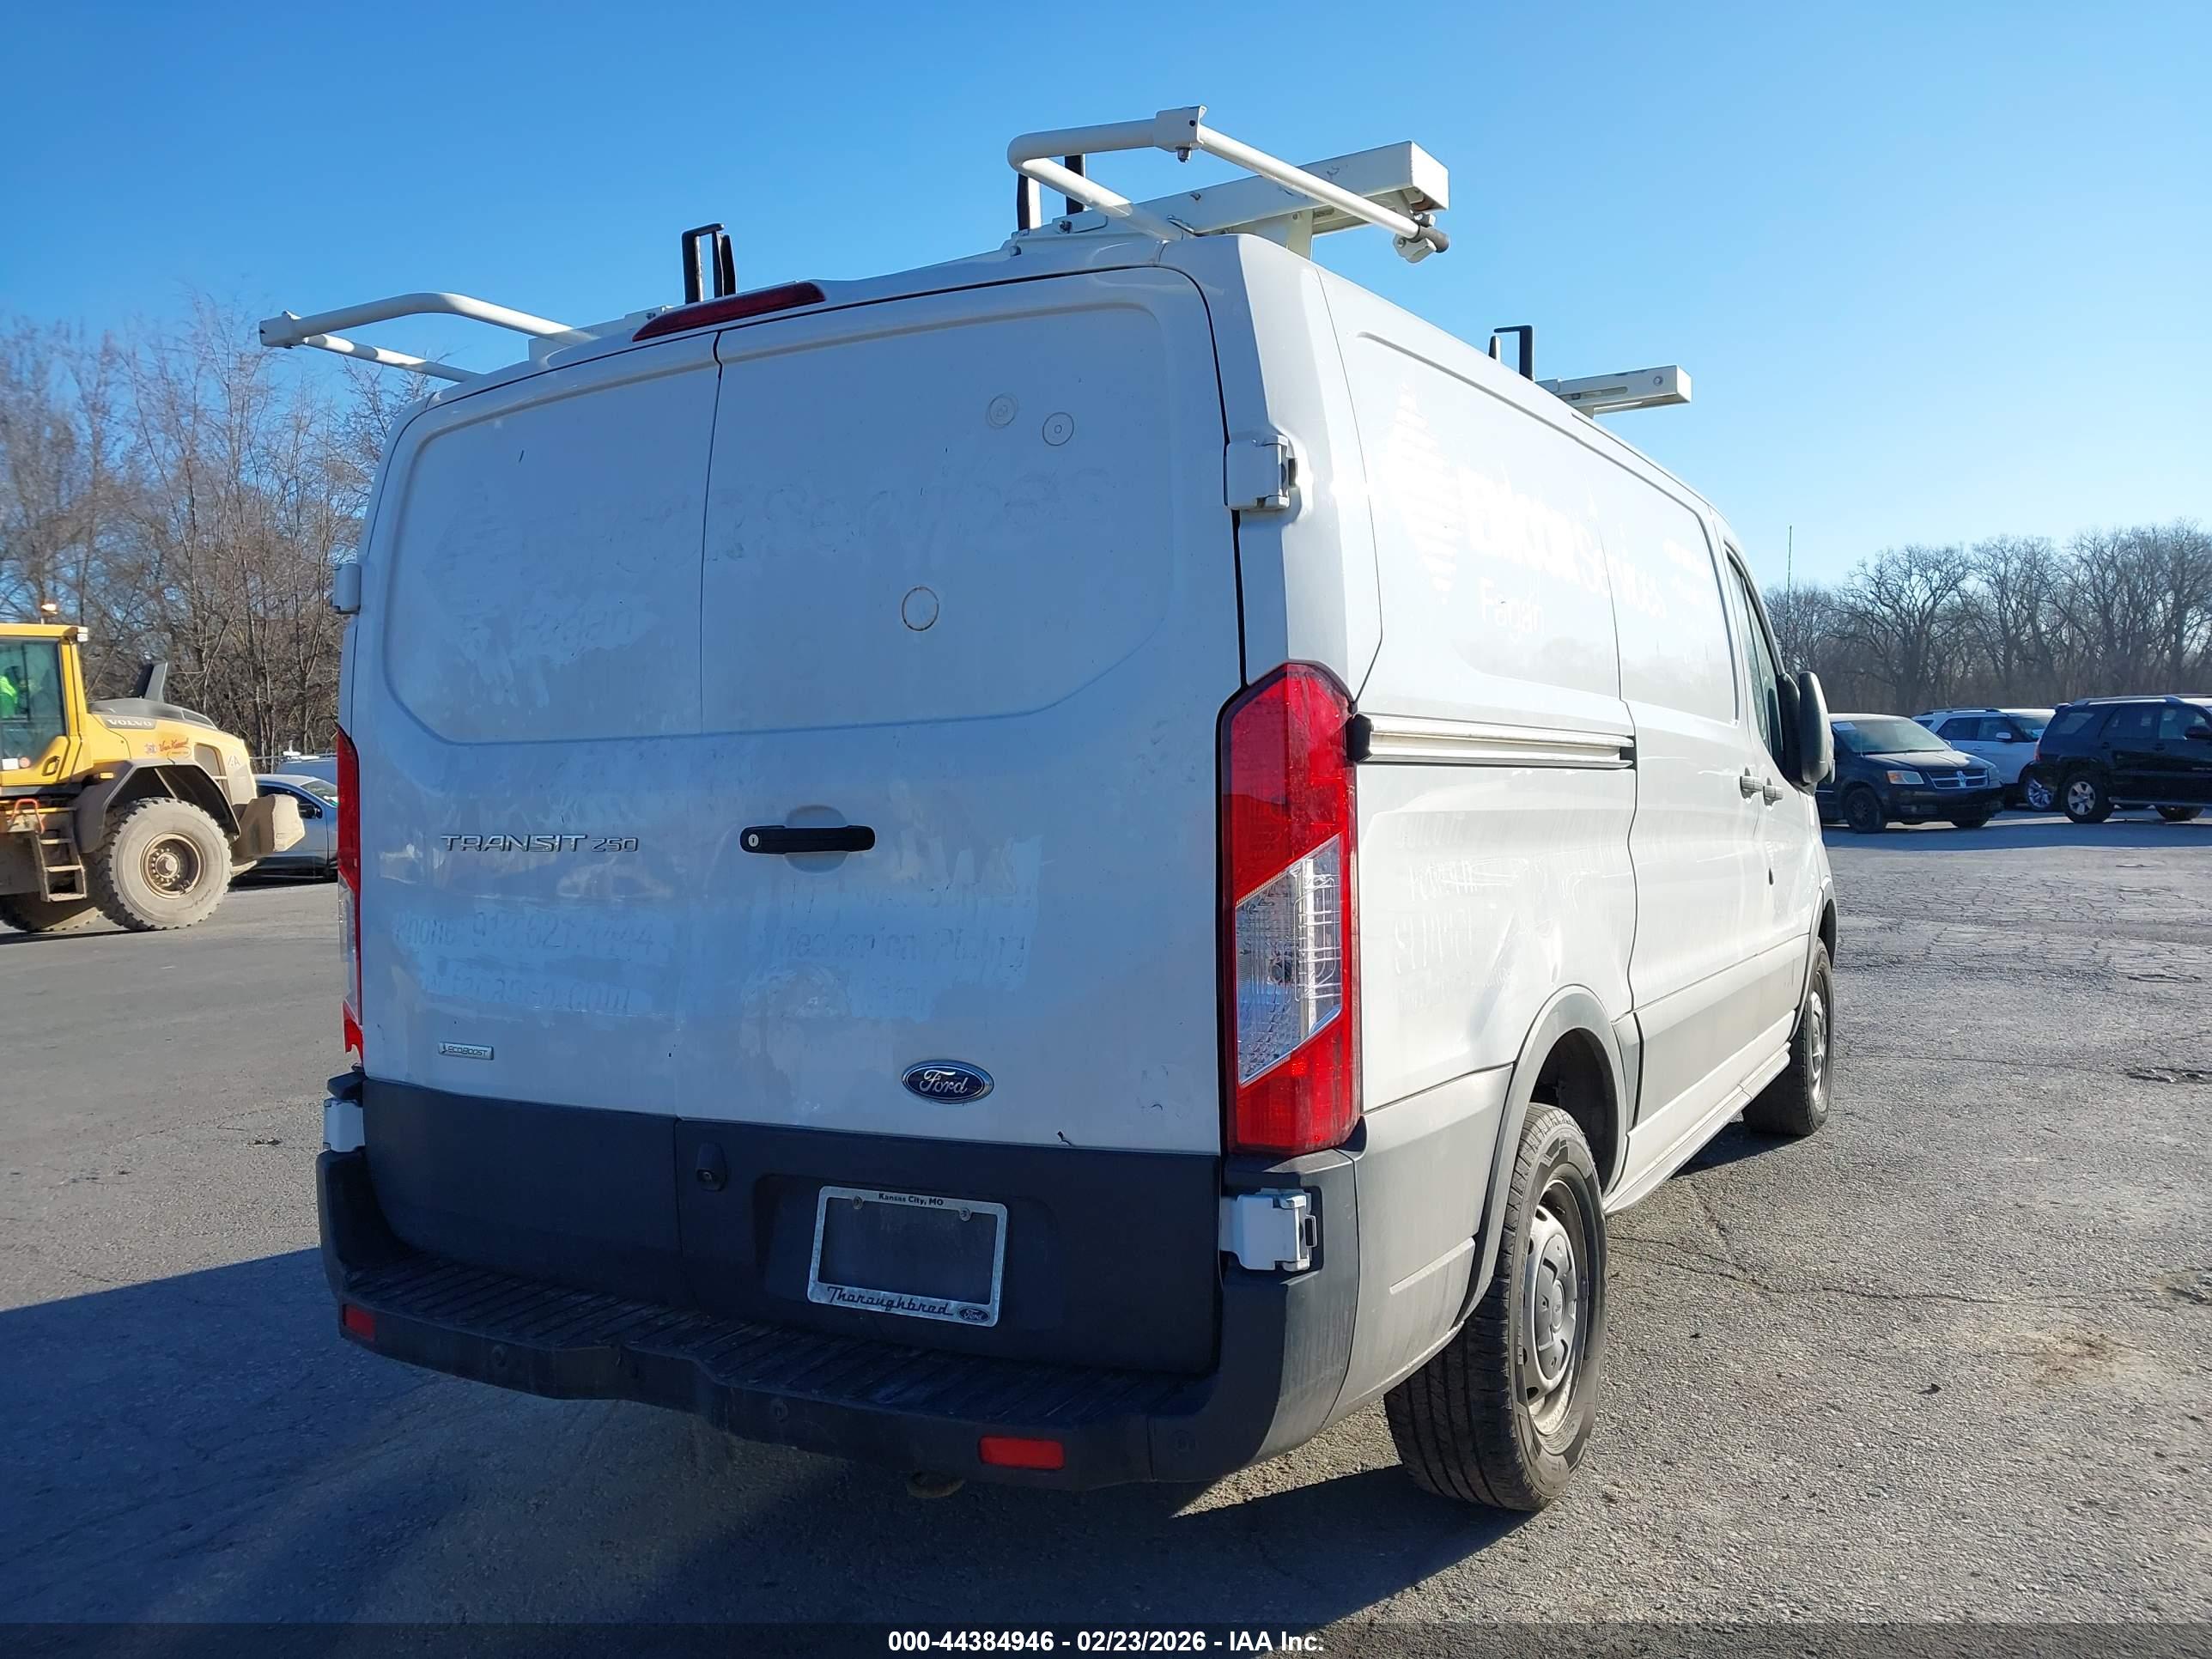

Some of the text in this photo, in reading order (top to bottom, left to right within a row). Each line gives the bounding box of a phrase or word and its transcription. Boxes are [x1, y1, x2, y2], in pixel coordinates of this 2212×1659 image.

[106, 718, 153, 727] VOLVO
[440, 833, 639, 853] TRANSIT 250
[919, 1069, 969, 1094] Ford
[878, 1193, 945, 1206] Kansas City, MO
[827, 1286, 954, 1316] Thoroughbred
